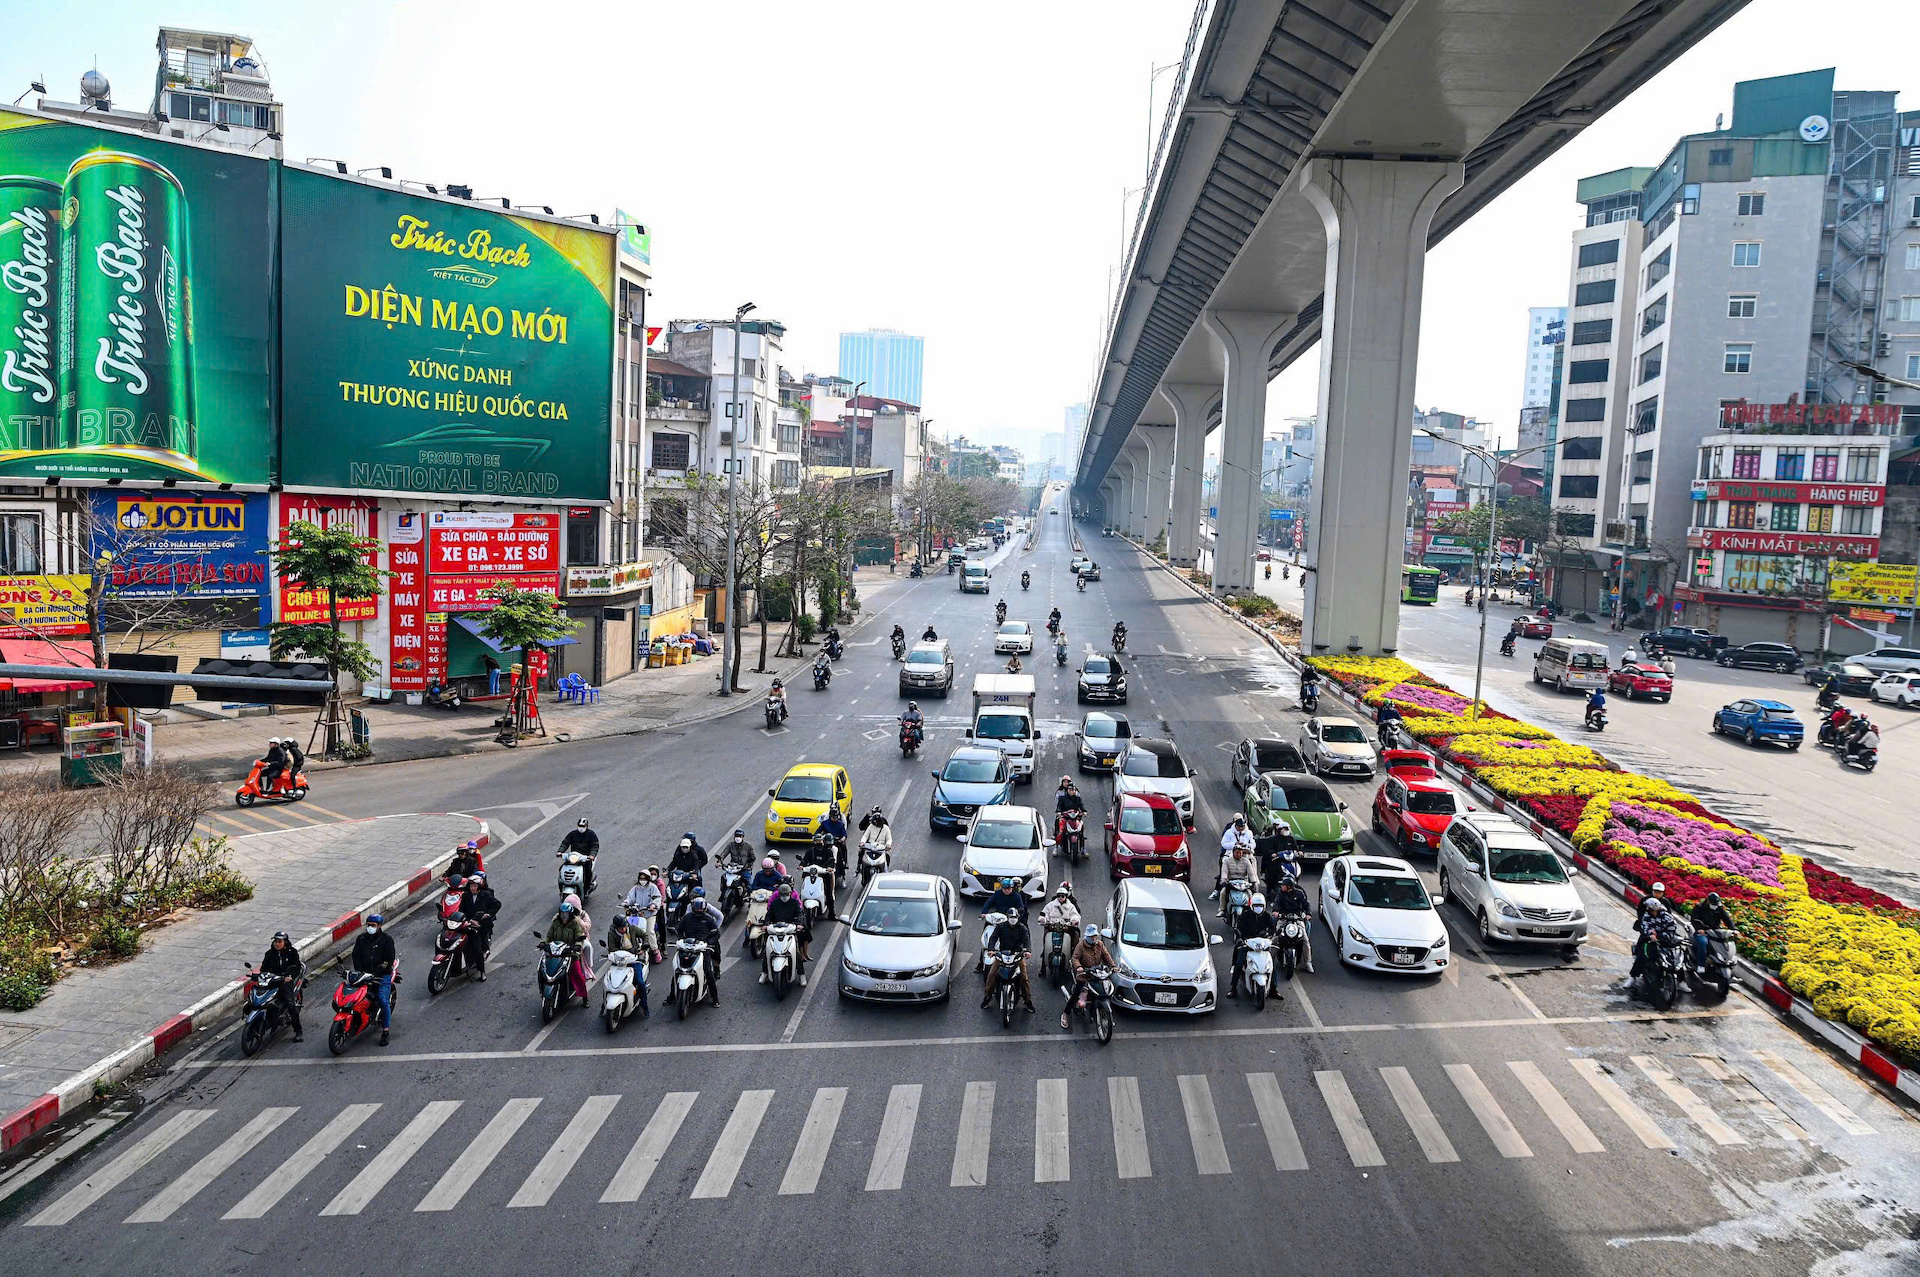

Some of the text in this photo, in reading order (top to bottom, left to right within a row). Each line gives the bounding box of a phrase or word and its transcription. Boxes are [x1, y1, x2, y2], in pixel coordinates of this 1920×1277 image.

[390, 214, 532, 268] Trúc Bạch
[167, 265, 176, 287] BIA
[432, 270, 487, 286] KIỆT TÁC BIA
[95, 184, 151, 395] Trúc Bạch
[1, 206, 56, 404] Trúc Bạch
[344, 282, 568, 344] DIỆN MẠO MỚI
[408, 357, 512, 386] XỨNG DANH
[339, 381, 569, 421] THƯƠNG HIỆU QUỐC GIA
[419, 450, 501, 468] PROUD TO BE
[350, 462, 559, 494] NATIONAL BRAND
[1756, 487, 1797, 499] TRANG
[1810, 486, 1847, 501] HÀNG
[1849, 488, 1879, 505] HIỆU
[151, 505, 241, 528] JOTUN
[440, 529, 461, 542] SỬA
[462, 530, 489, 542] CHỮA
[497, 529, 516, 542] BẢO
[518, 530, 550, 542] DƯỠNG
[1720, 534, 1757, 550] KÍNH
[1759, 534, 1795, 552] MẮT
[1835, 543, 1872, 556] ANH
[395, 548, 419, 565] SỬA
[442, 547, 462, 562] XE
[467, 547, 488, 561] GA
[503, 546, 523, 560] XE
[527, 542, 548, 561] SỐ
[111, 557, 265, 585] BÁCH HÓA SƠN
[400, 572, 414, 585] XE
[287, 590, 346, 606] CHO TH
[394, 590, 420, 607] MÁY
[433, 590, 448, 602] XE
[450, 589, 466, 602] GA
[284, 610, 321, 621] HOTLINE:
[361, 606, 375, 616] 959
[400, 614, 415, 627] XE
[394, 632, 421, 650] ĐIỆN
